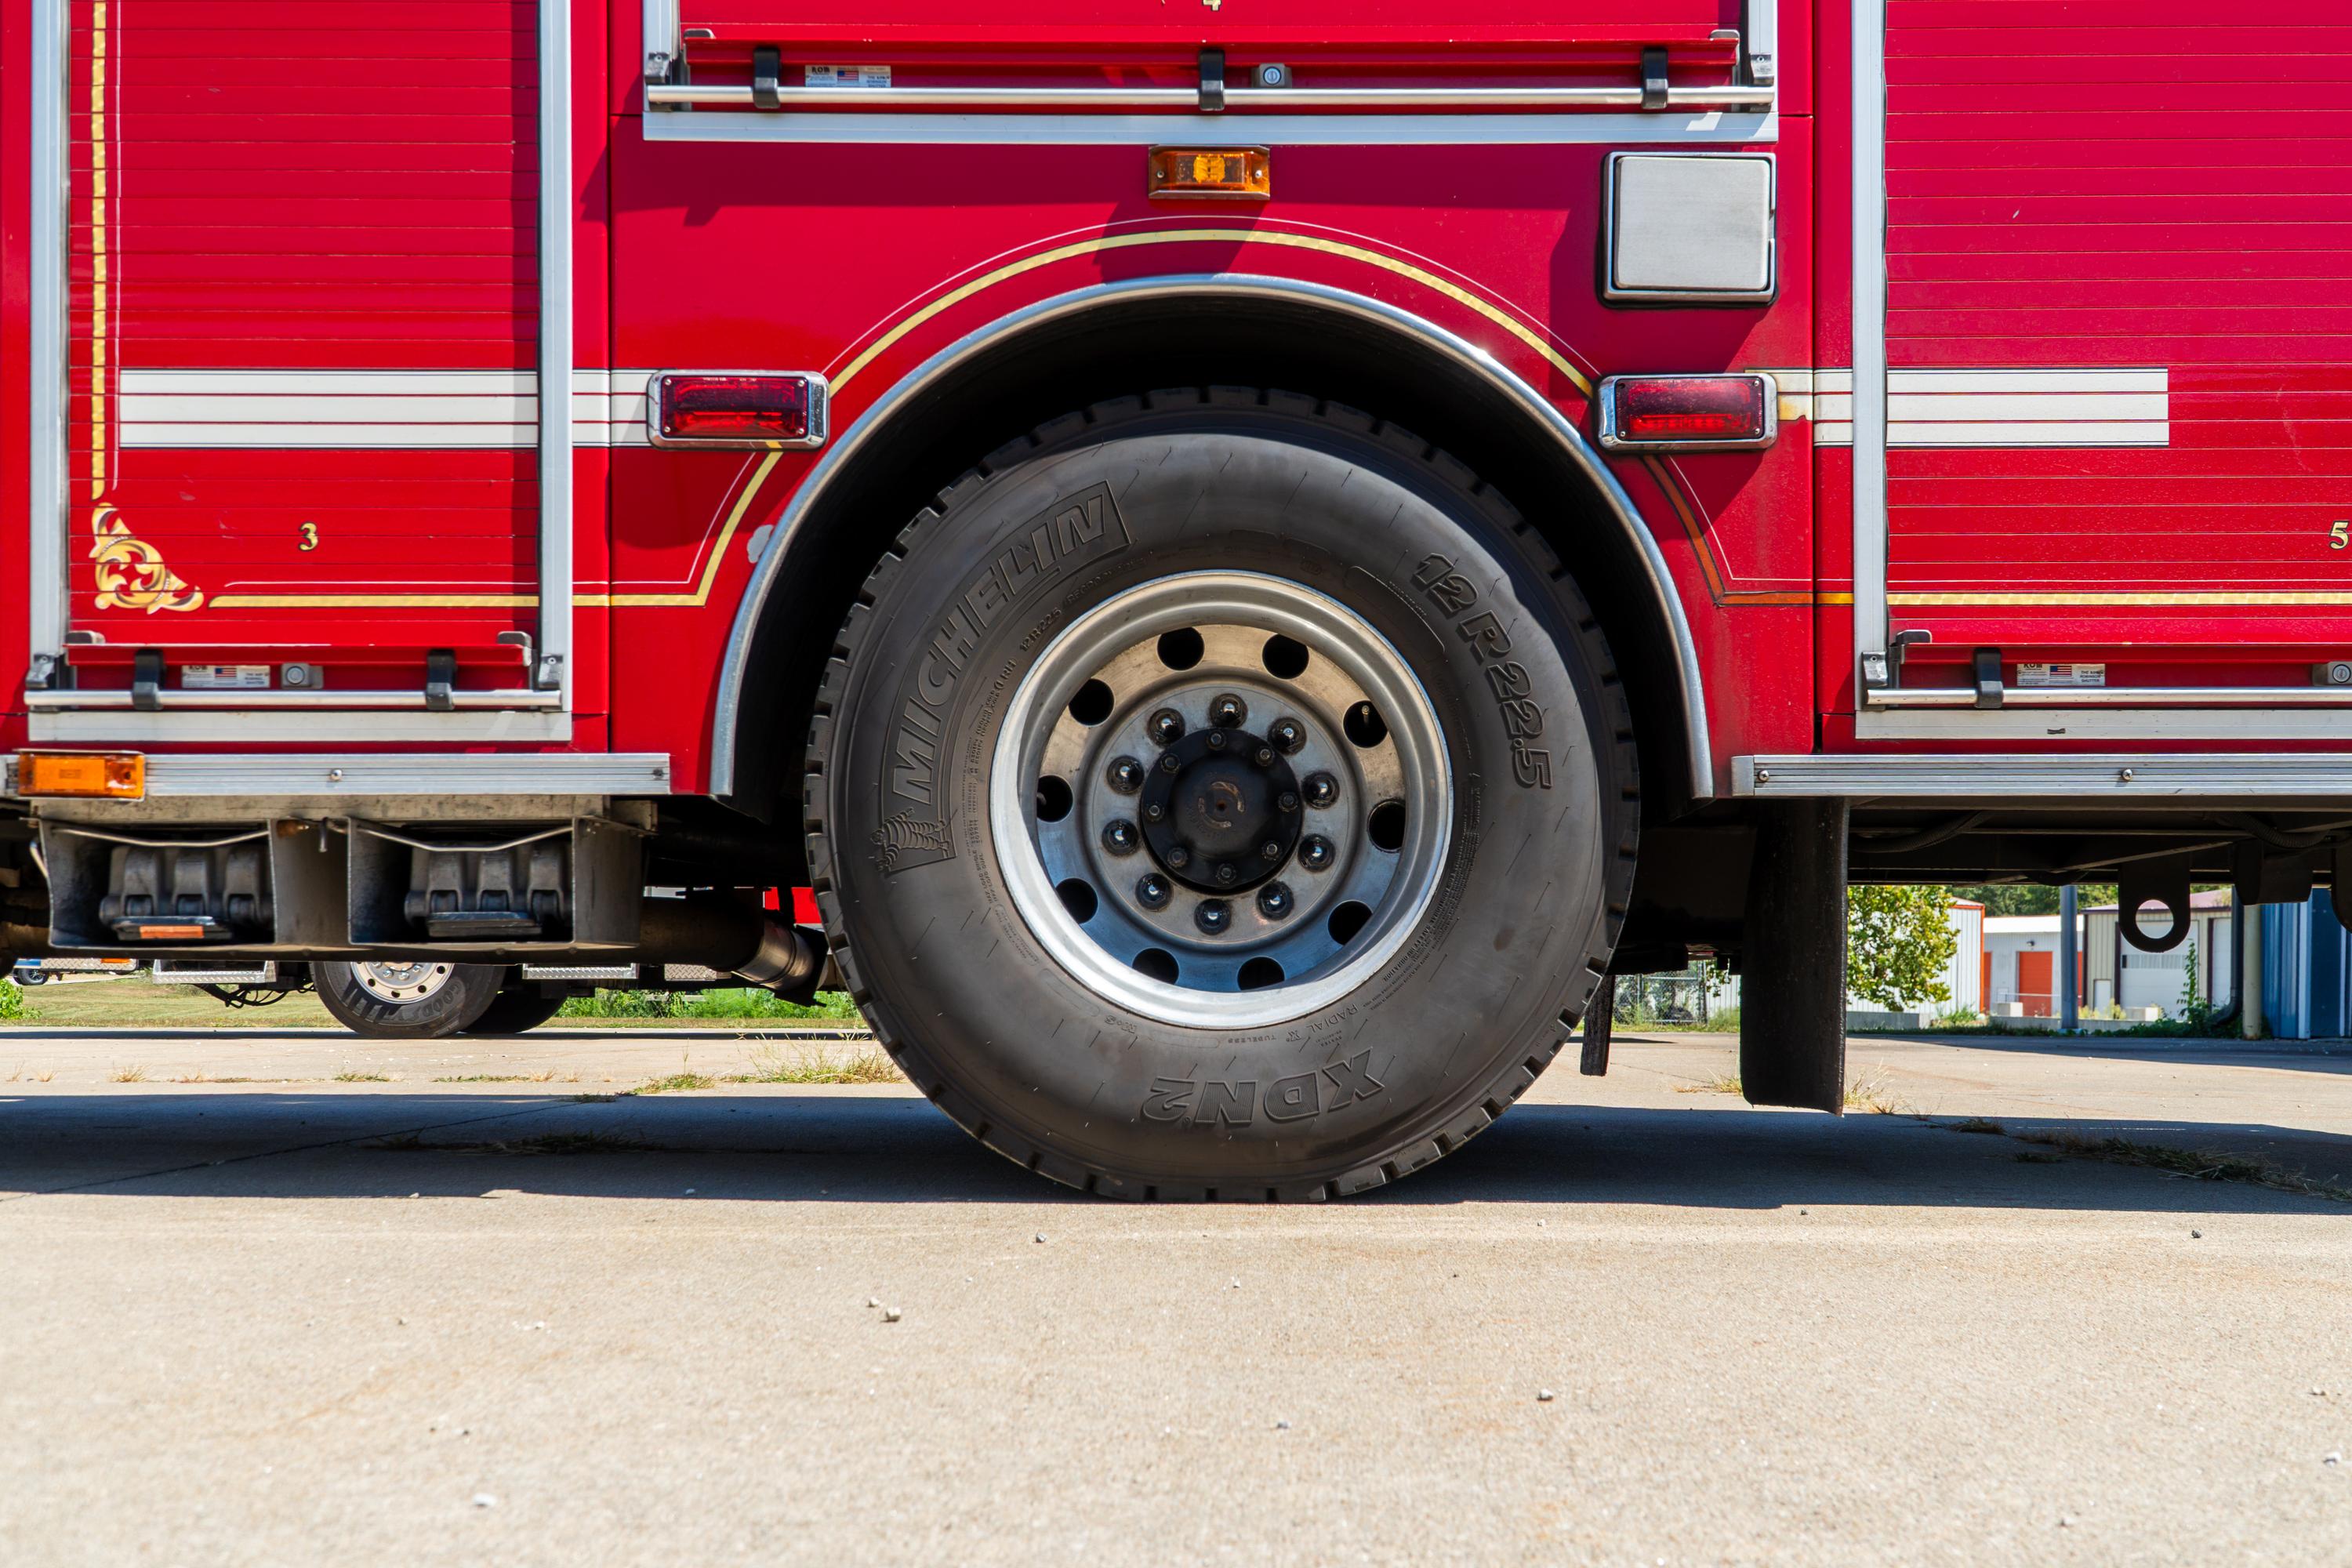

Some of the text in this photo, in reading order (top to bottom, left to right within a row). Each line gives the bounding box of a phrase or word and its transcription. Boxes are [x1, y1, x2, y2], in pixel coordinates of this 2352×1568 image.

[299, 521, 318, 552] 3
[2328, 520, 2350, 550] 5
[894, 494, 1106, 806] MICHELIN
[1308, 1004, 1359, 1035] RADIAL
[1227, 1033, 1277, 1045] TUBELESS
[1140, 1047, 1386, 1124] XDN2
